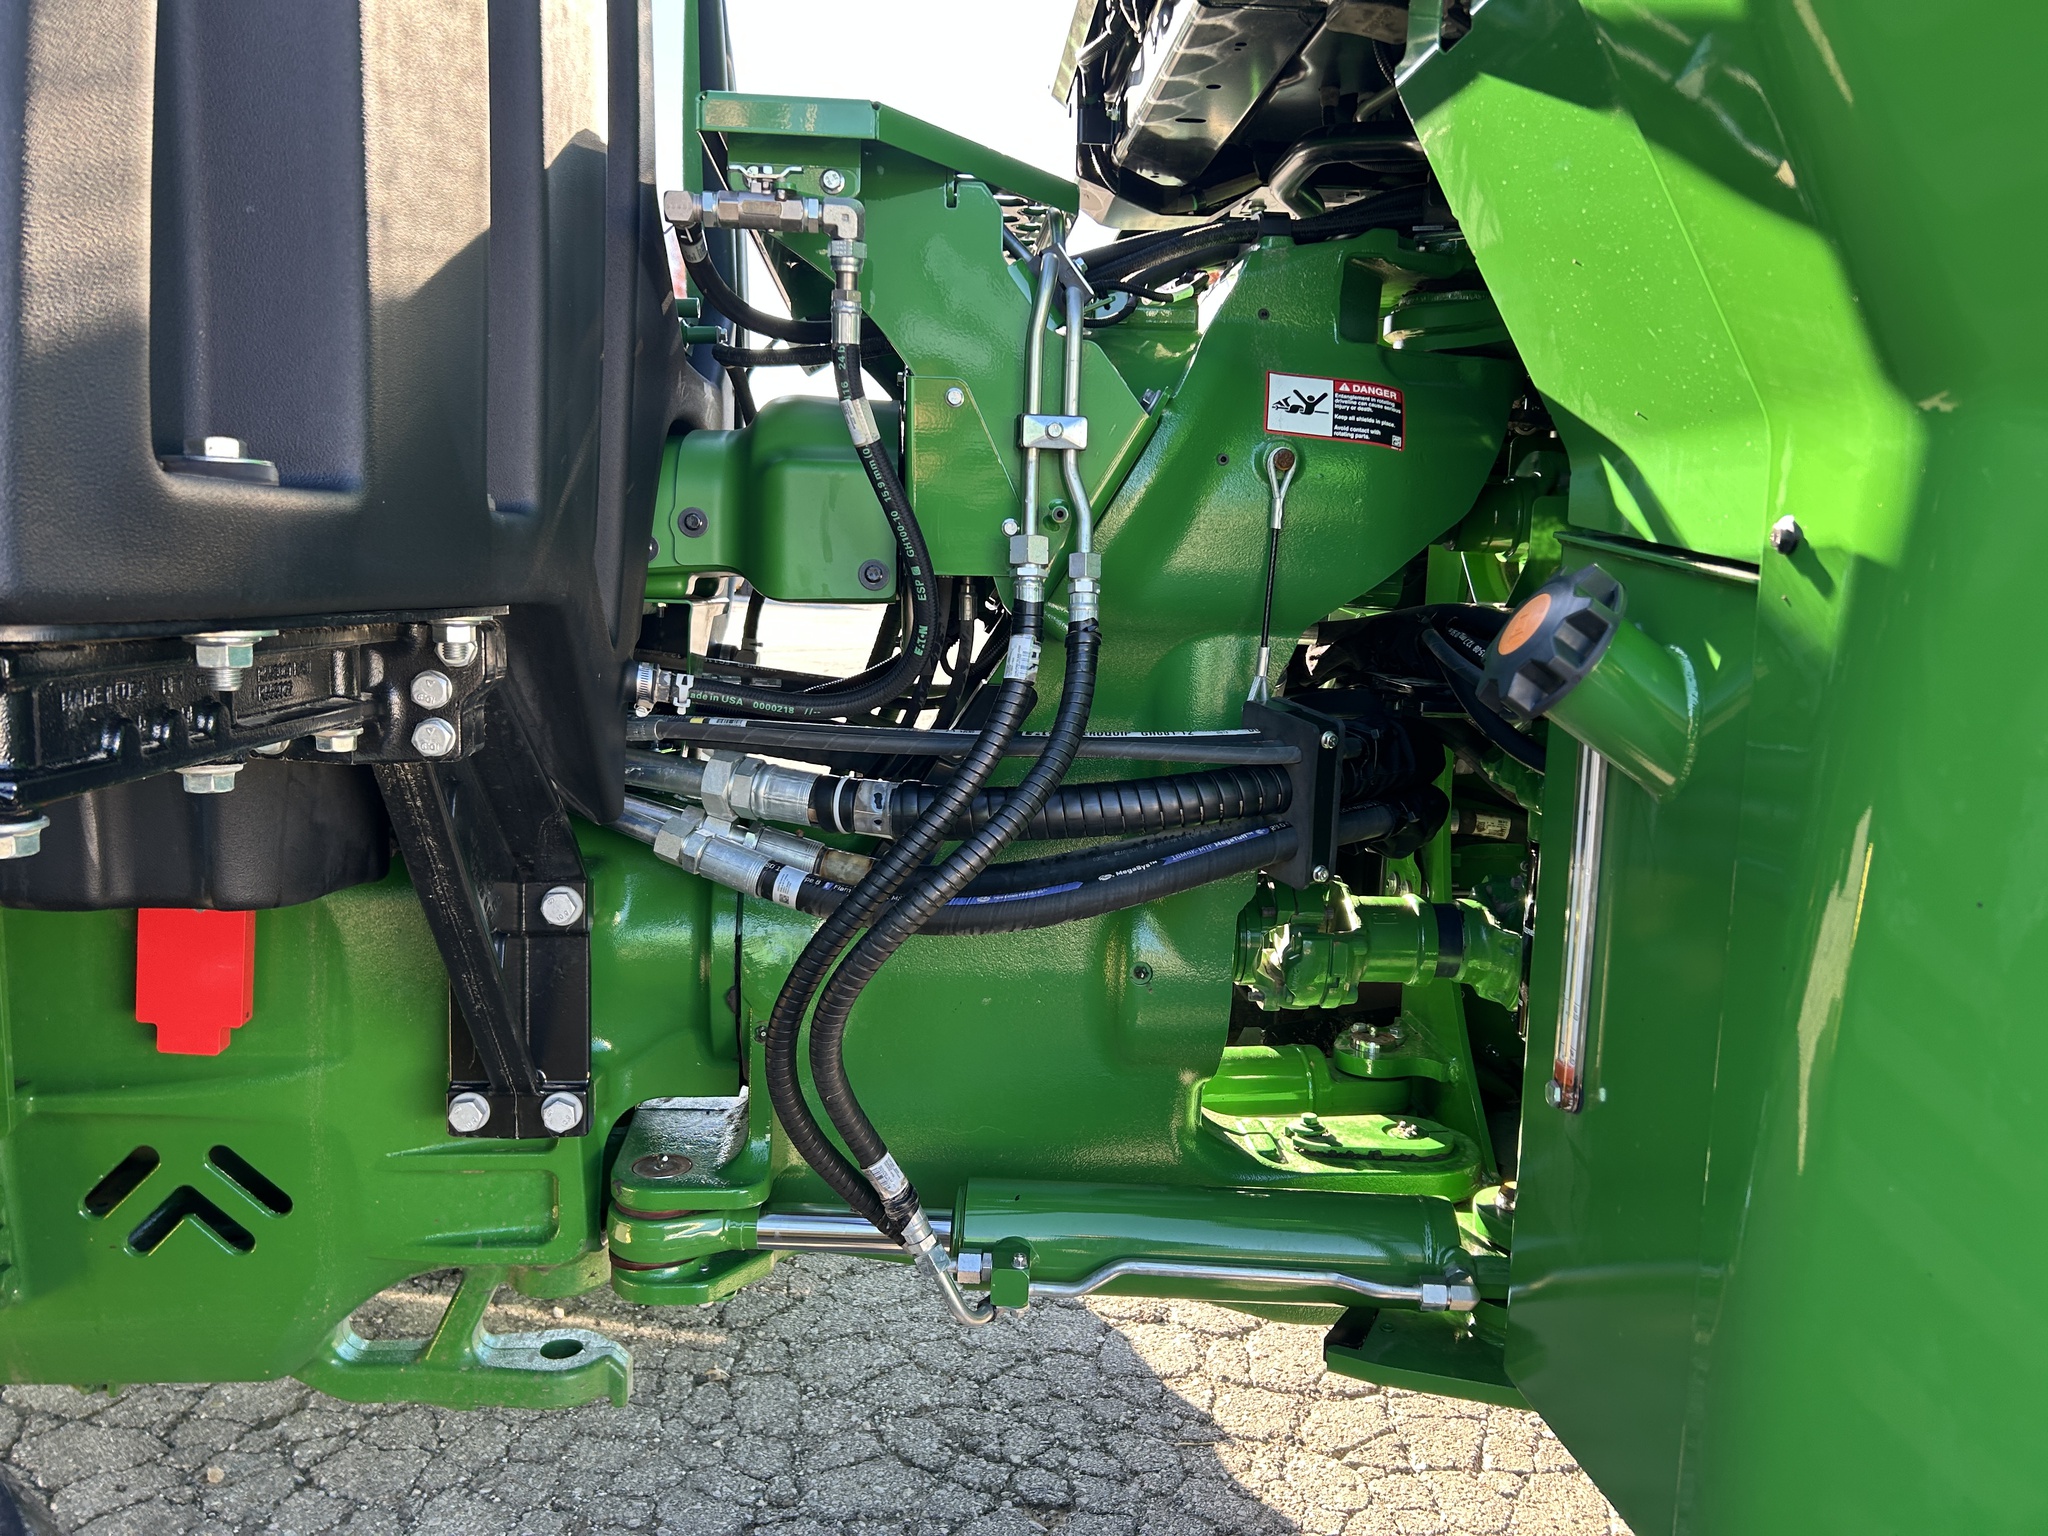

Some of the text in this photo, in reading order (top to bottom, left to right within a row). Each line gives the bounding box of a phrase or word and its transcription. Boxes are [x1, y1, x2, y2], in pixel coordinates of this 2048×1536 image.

[838, 354, 846, 370] 24
[1334, 392, 1370, 402] Entanglement
[1377, 398, 1396, 408] rotating
[1352, 384, 1397, 400] DANGER
[1384, 405, 1402, 414] serious
[1334, 414, 1348, 422] Keep
[1381, 420, 1396, 428] place.
[1334, 431, 1354, 439] rotating
[868, 460, 882, 480] mm
[877, 482, 892, 502] 15.9
[890, 510, 915, 558] GH100-10
[914, 580, 927, 600] ESP
[688, 691, 708, 700] ade
[710, 692, 719, 702] in
[721, 694, 744, 706] USA
[752, 701, 794, 714] 0000218
